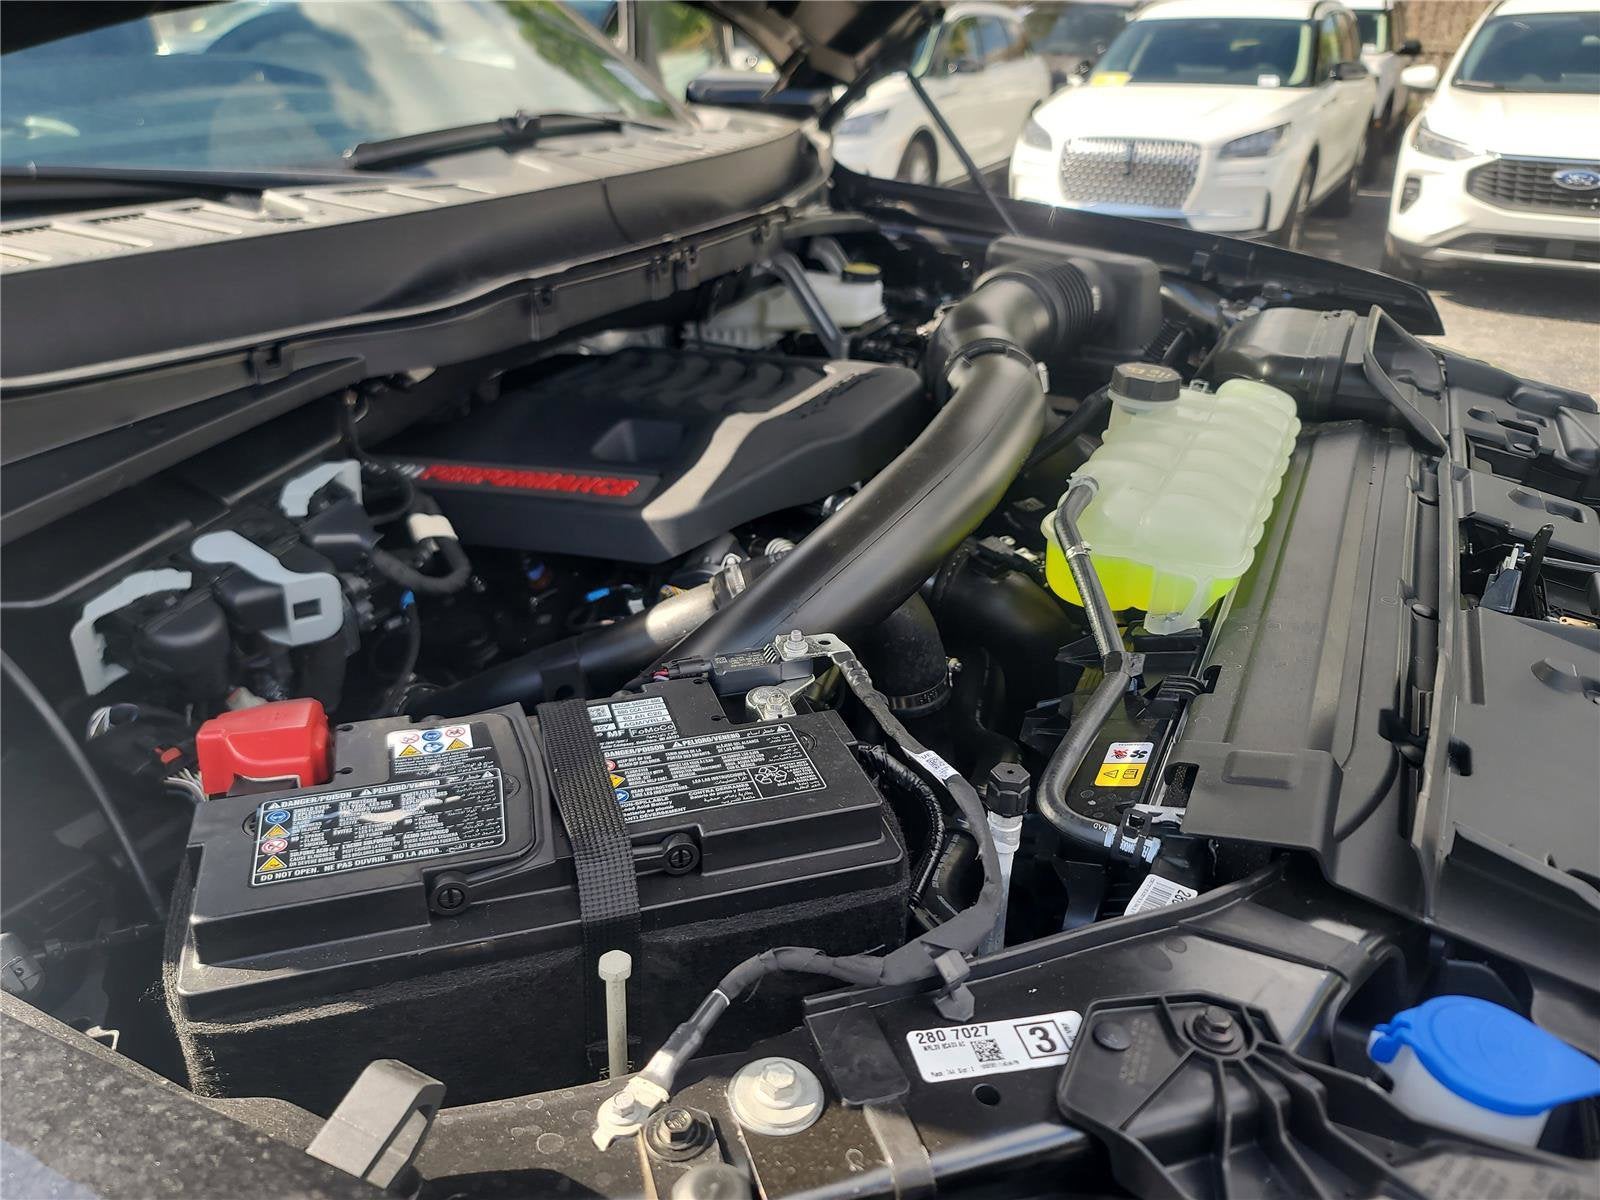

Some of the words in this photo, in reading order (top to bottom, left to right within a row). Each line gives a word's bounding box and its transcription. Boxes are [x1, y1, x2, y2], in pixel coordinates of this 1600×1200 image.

[606, 729, 625, 738] MF
[631, 724, 674, 736] FoMoCo
[604, 744, 665, 758] DANGER/POISON
[372, 779, 441, 796] PELIGRO/VENENO
[280, 791, 352, 808] DANGER/POISON
[392, 851, 406, 860] NO
[406, 849, 417, 858] LA
[418, 847, 443, 857] ABRA.
[323, 864, 336, 873] NE
[336, 860, 353, 870] PAS
[354, 854, 389, 866] OUVRIR.
[260, 873, 274, 882] DO
[275, 870, 292, 879] NOT
[294, 866, 320, 877] OPEN.
[915, 1029, 947, 1044] 280
[950, 1025, 990, 1040] 7027
[1028, 1026, 1057, 1053] 3
